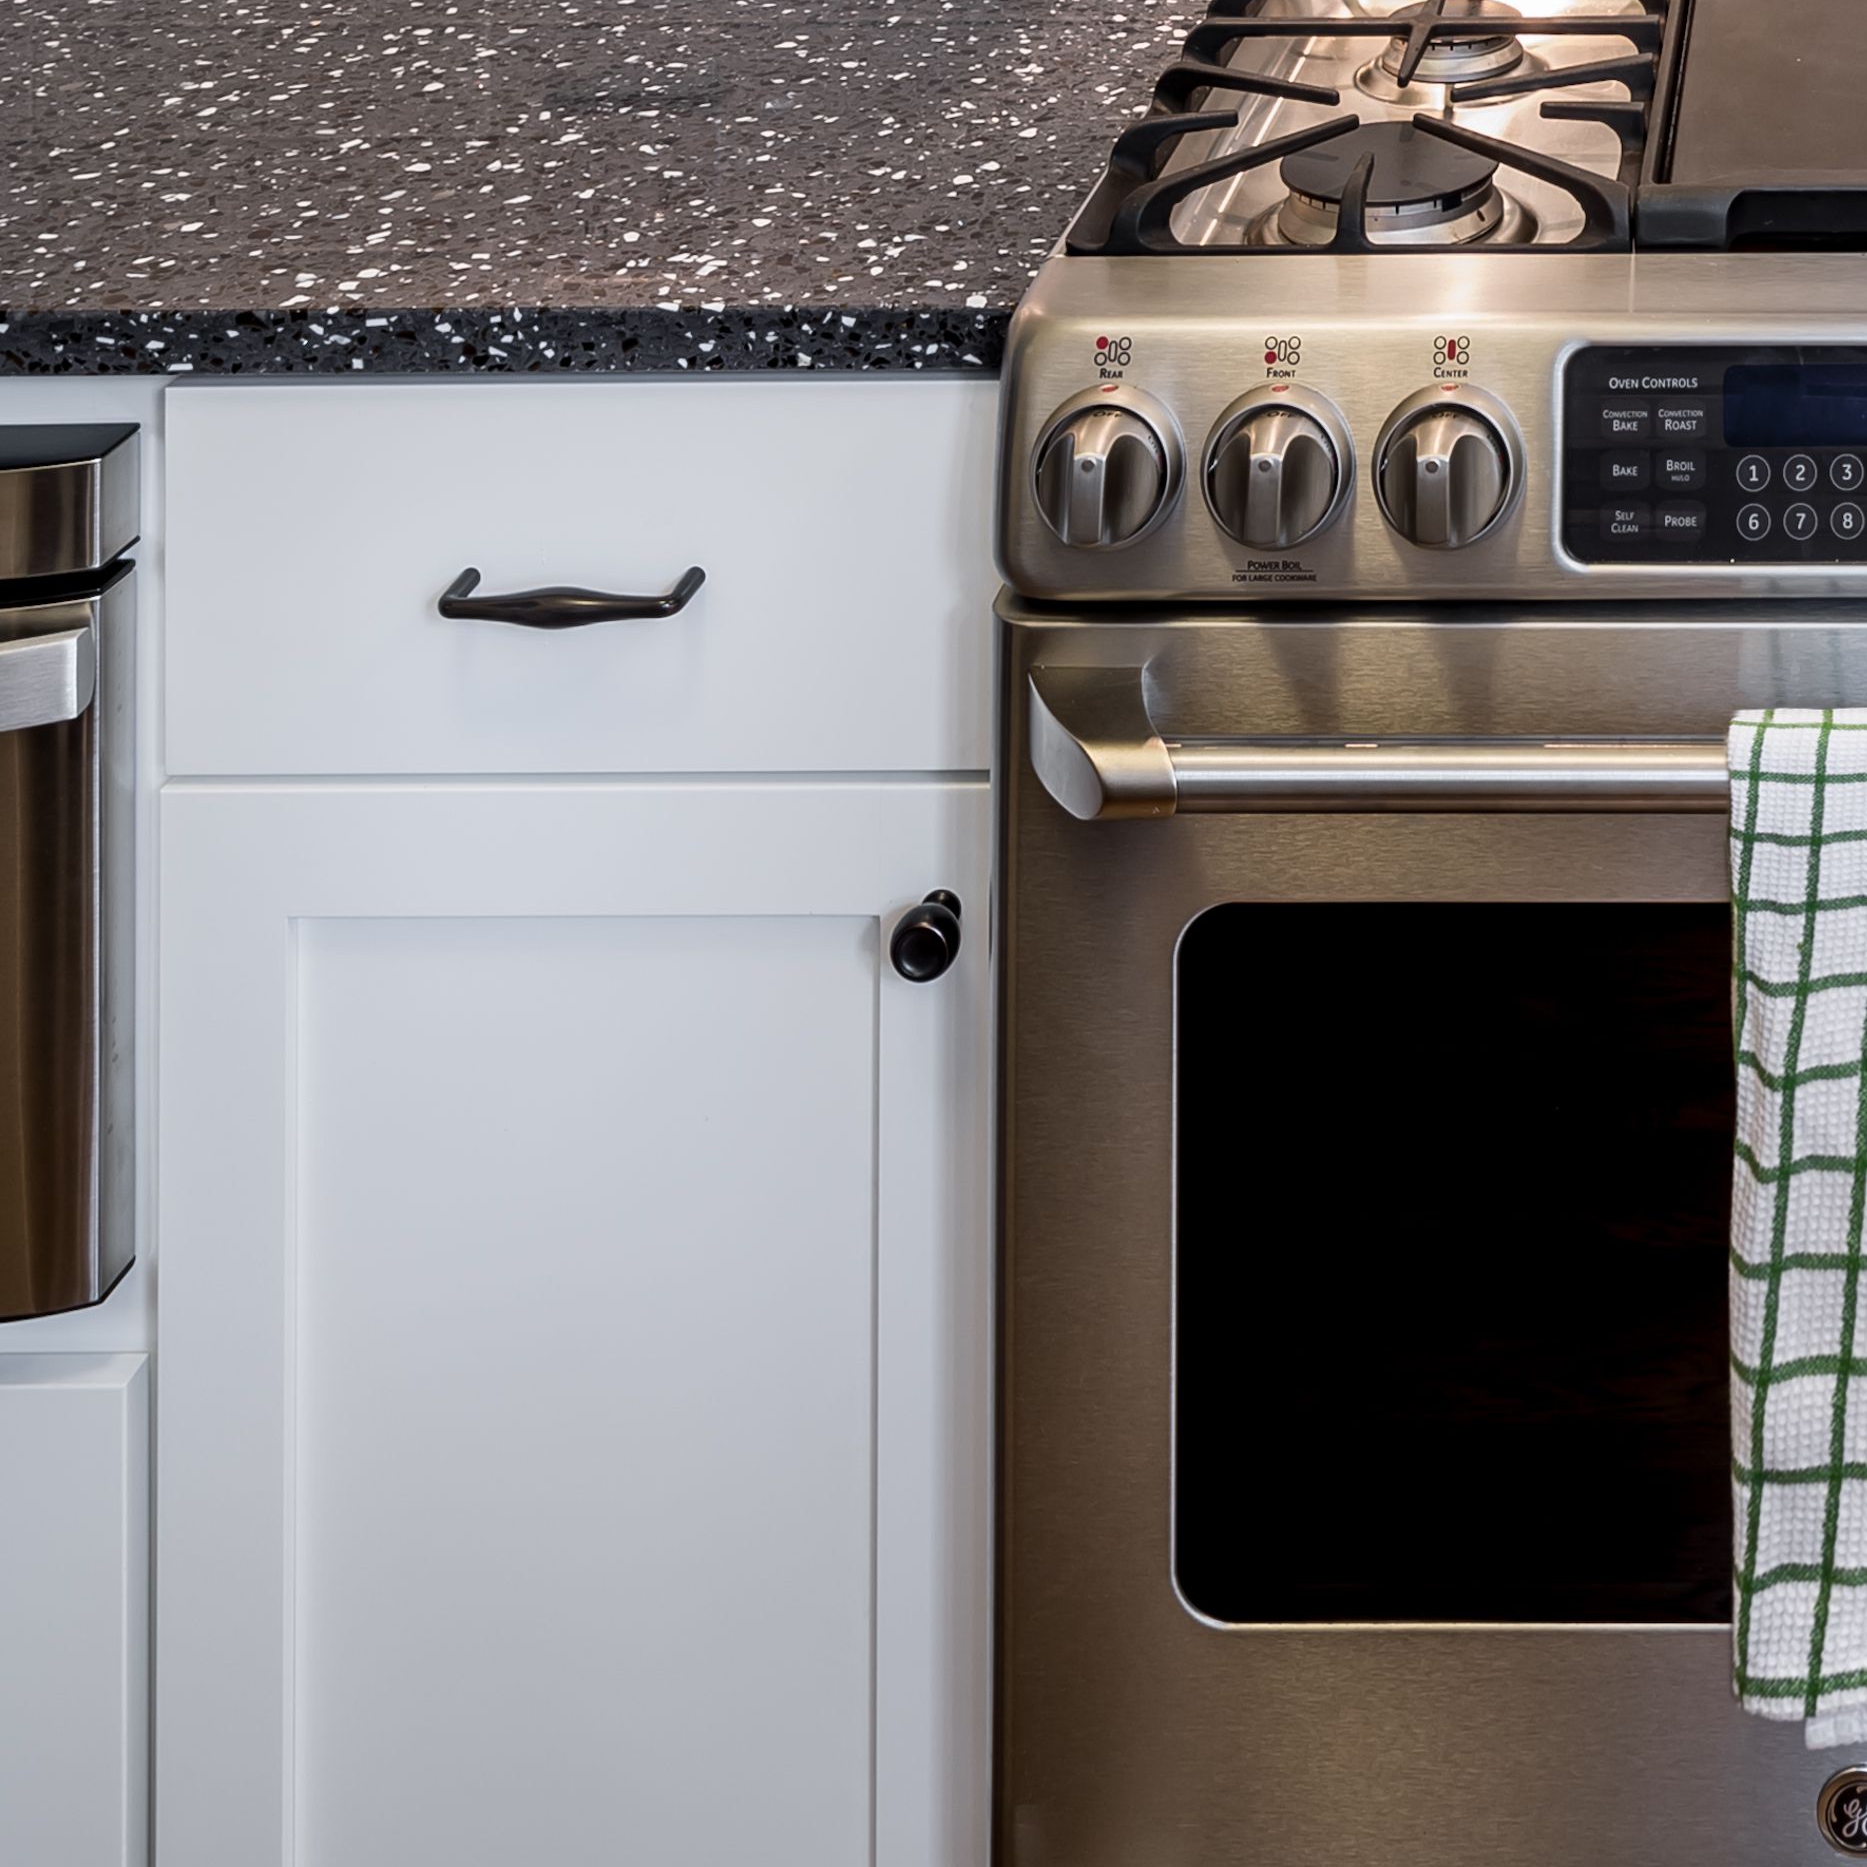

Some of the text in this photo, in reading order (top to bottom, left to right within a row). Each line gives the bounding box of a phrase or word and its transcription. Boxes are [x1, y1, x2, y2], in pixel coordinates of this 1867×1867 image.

[1100, 368, 1124, 379] REAR
[1266, 368, 1296, 379] FRONT
[1434, 367, 1468, 379] CENTER
[1608, 377, 1698, 389] OVEN CONTROLS
[1602, 409, 1648, 419] CONVECTION
[1658, 409, 1704, 419] CONVECTION
[1612, 420, 1638, 432] BAKE
[1664, 419, 1698, 431] ROAST
[1612, 465, 1638, 477] BAKE
[1666, 459, 1695, 471] BROIL
[1749, 465, 1759, 481] 1
[1795, 464, 1806, 481] 2
[1842, 463, 1852, 481] 3
[1615, 511, 1634, 522] SELF
[1664, 515, 1697, 527] PROBE
[1748, 513, 1759, 531] 6
[1796, 513, 1806, 530] 7
[1842, 513, 1853, 529] 8
[1610, 522, 1638, 533] CLEAN
[1247, 560, 1301, 571] POWER BOIL
[1232, 574, 1318, 583] FOR LARGE COOKWARE
